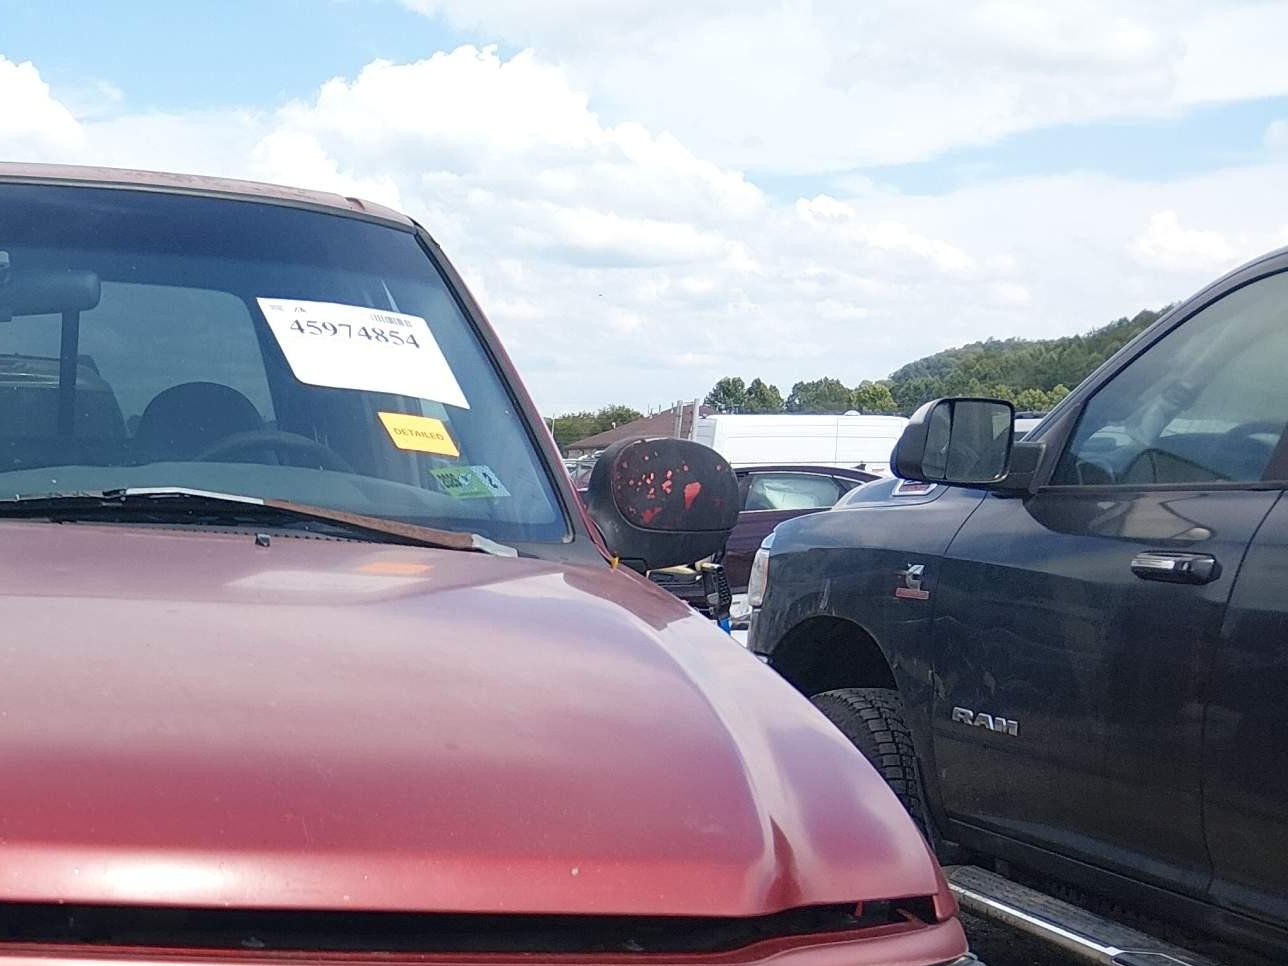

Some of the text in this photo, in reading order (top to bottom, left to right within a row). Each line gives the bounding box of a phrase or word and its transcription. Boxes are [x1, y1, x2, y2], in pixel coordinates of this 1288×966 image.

[290, 319, 420, 349] 45974854
[394, 427, 445, 441] DETAILED
[952, 706, 1018, 737] RAM
